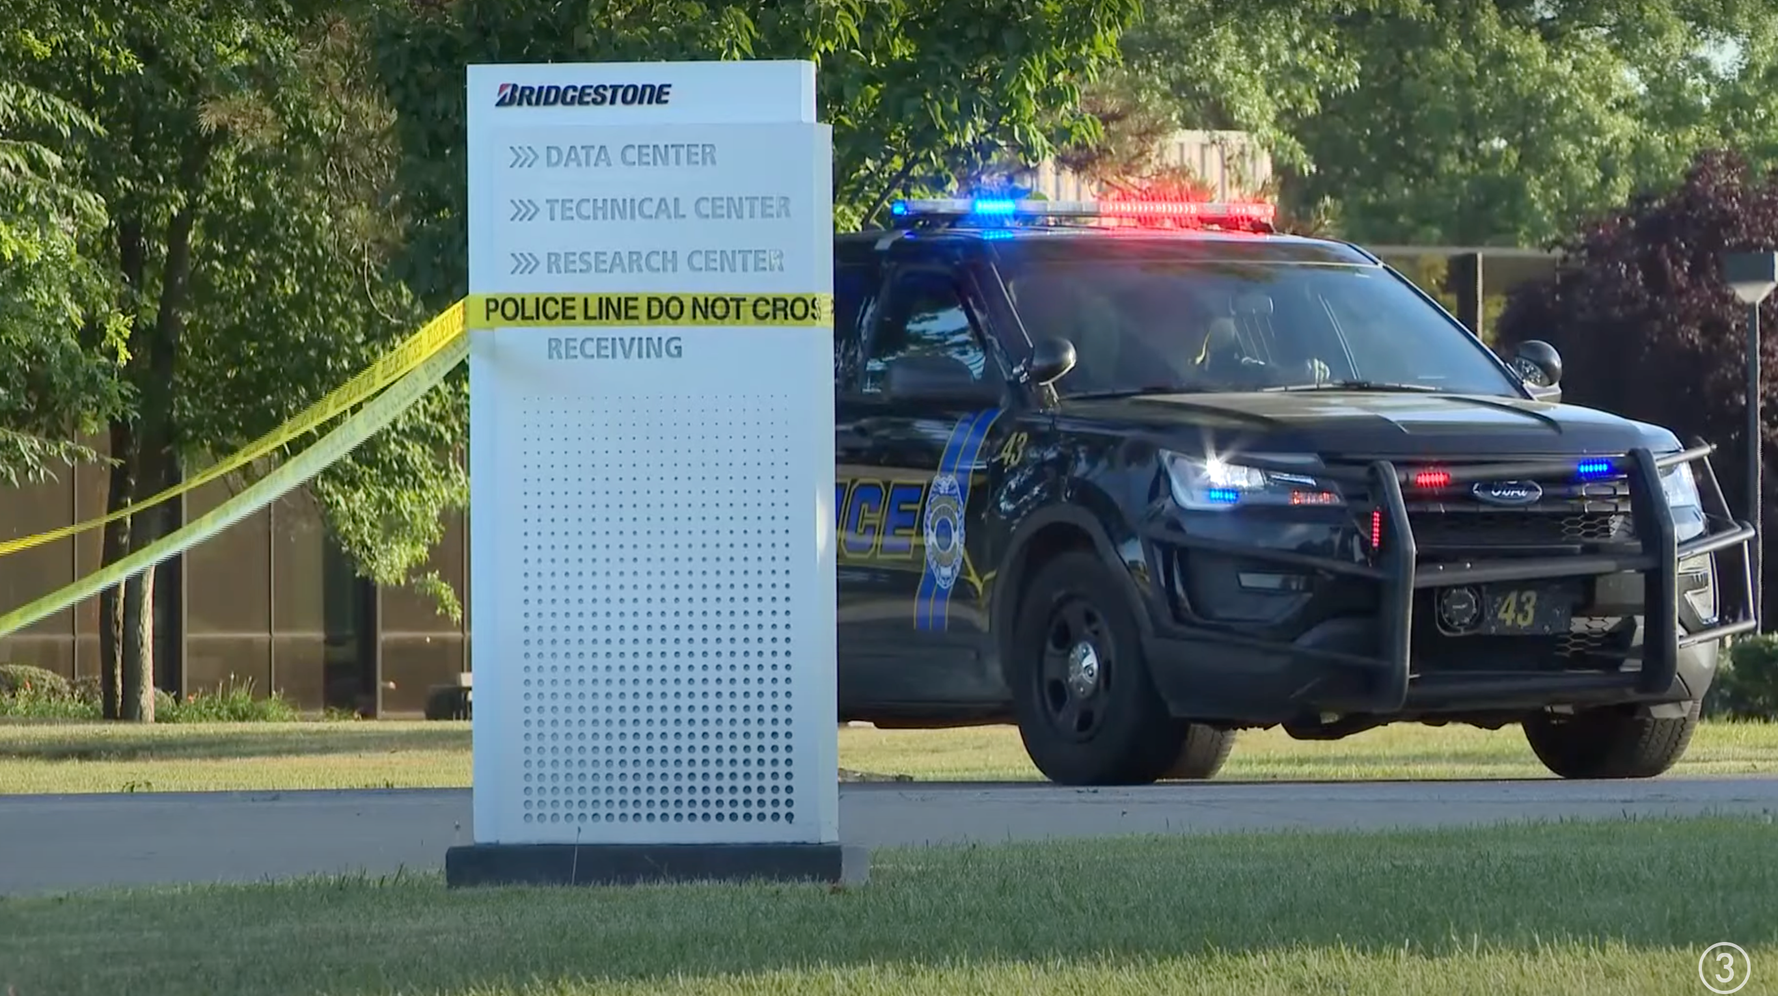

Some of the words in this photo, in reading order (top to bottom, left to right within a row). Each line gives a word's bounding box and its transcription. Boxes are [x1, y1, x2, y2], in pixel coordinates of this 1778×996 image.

[495, 83, 673, 108] BRIDGESTONE
[545, 145, 613, 168] DATA
[620, 143, 718, 167] CENTER
[545, 197, 687, 221] TECHNICAL
[694, 196, 792, 219] CENTER
[546, 250, 679, 275] RESEARCH
[687, 249, 785, 273] CENTER
[485, 297, 577, 322] POLICE
[583, 297, 639, 321] LINE
[646, 296, 685, 321] DO
[691, 296, 747, 320] NOT
[751, 296, 833, 321] CROS
[547, 336, 684, 361] RECEIVING
[1000, 432, 1028, 466] 43
[1497, 589, 1538, 628] 43
